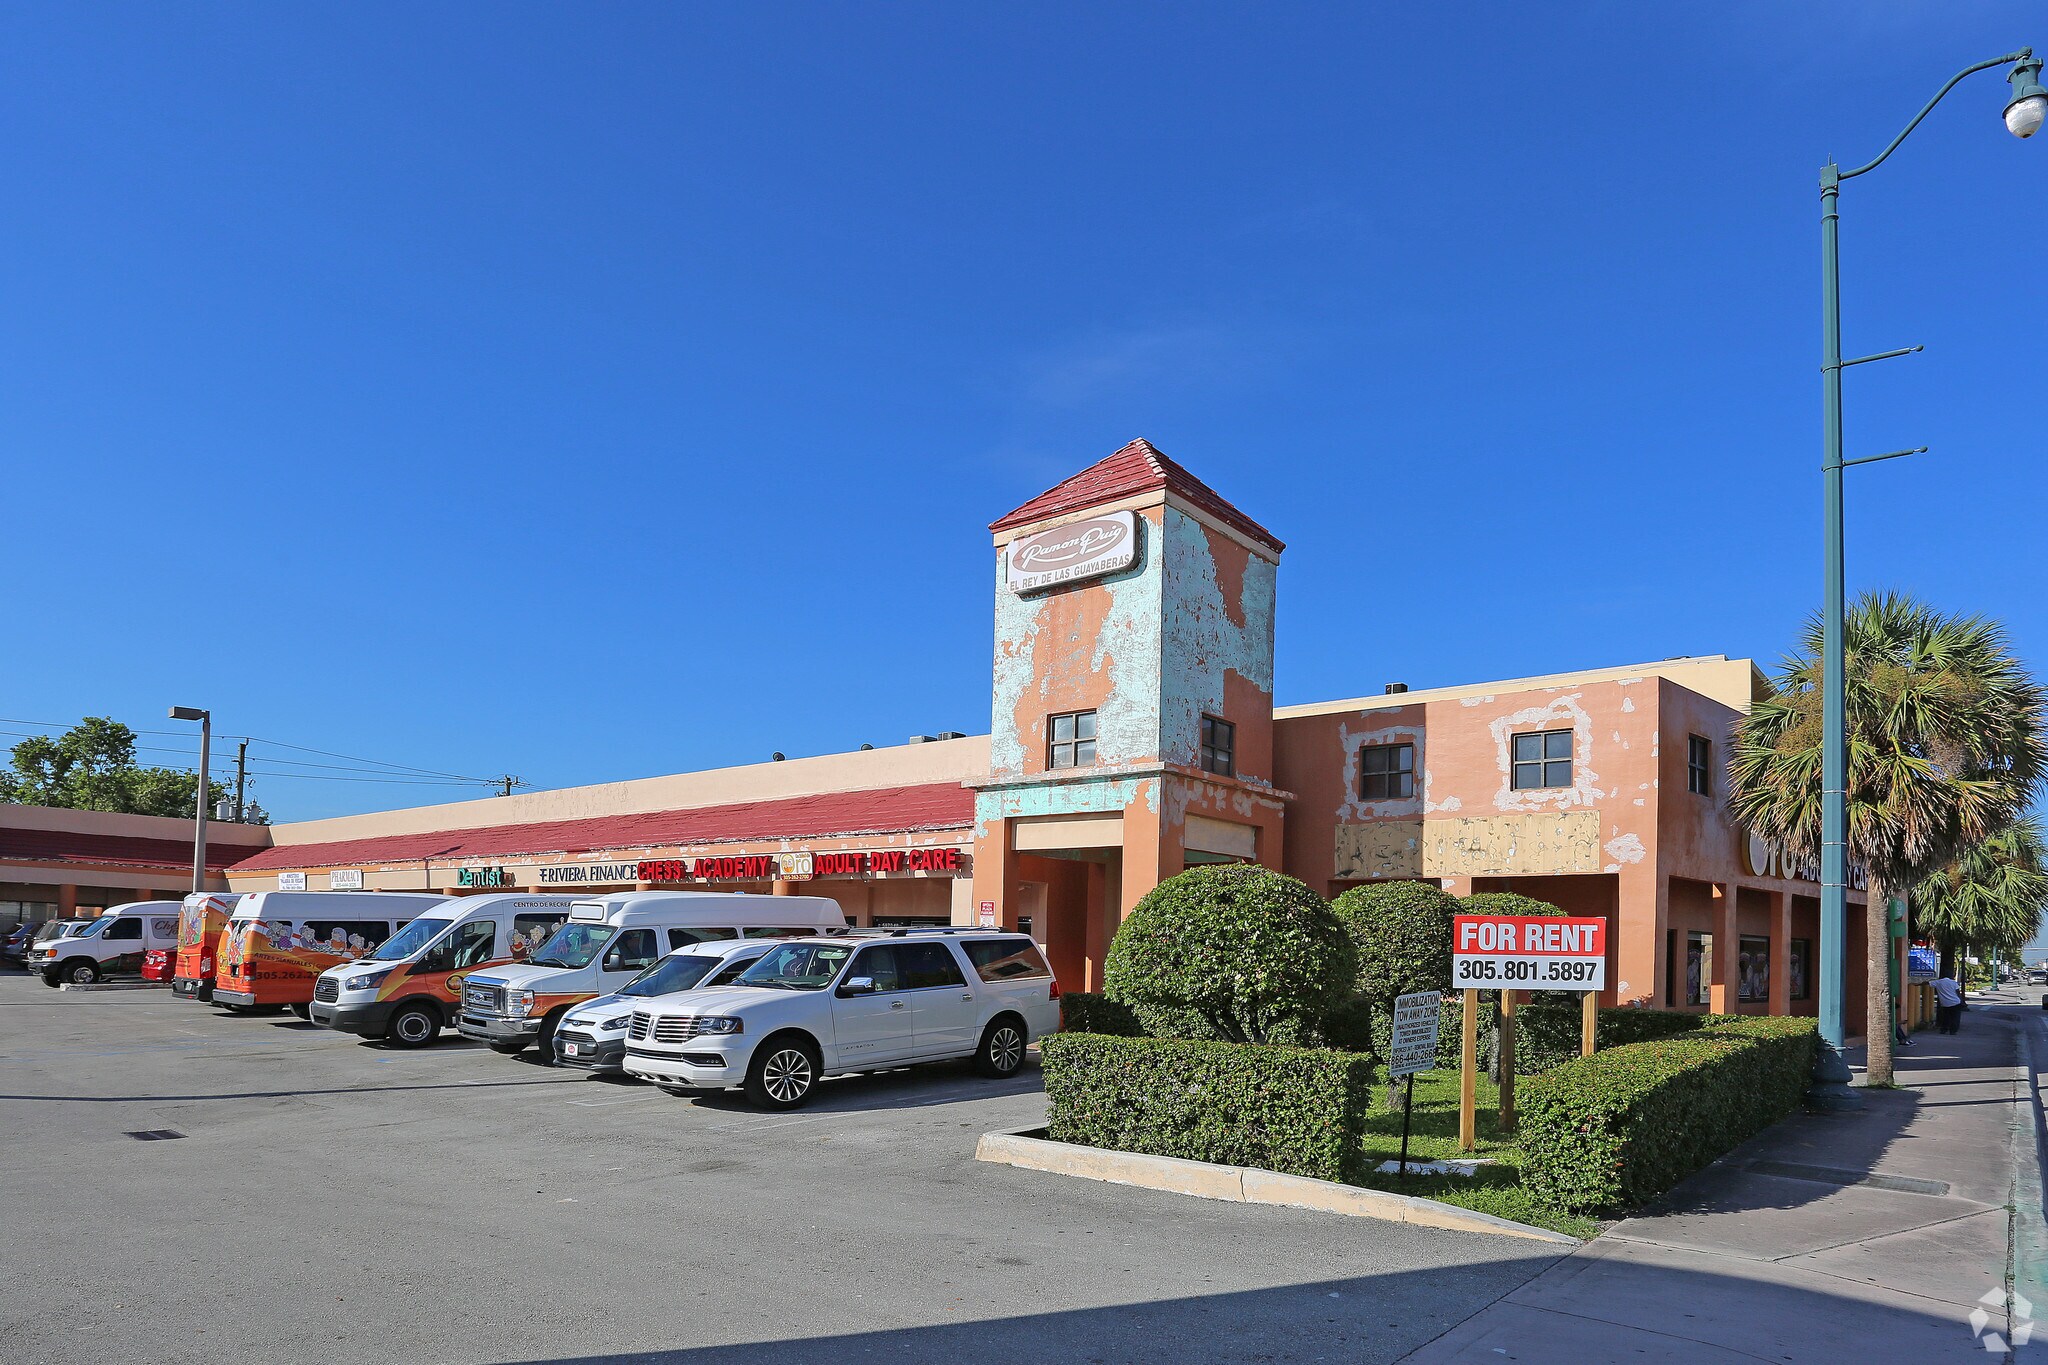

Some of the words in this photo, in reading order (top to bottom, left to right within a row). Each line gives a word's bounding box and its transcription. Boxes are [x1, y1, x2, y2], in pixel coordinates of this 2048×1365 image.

[1080, 525, 1123, 556] Puig
[1010, 580, 1019, 591] EL
[1022, 576, 1038, 588] REY
[1041, 573, 1052, 584] DE
[1055, 568, 1070, 581] LAS
[1074, 553, 1130, 577] GUAYABERAS
[589, 864, 638, 881] FINANCE
[637, 860, 684, 881] CHESS
[693, 855, 770, 879] ACADEMY
[815, 853, 864, 875] ADULT
[870, 850, 903, 872] DAY
[909, 848, 959, 871] CARE
[331, 870, 360, 883] PHARMACY
[458, 867, 501, 886] Dentist
[1460, 922, 1517, 951] FOR
[1524, 922, 1598, 952] RENT
[1459, 959, 1597, 982] 305.801.5897
[1398, 993, 1440, 1009] IMMOBILIZATION
[1397, 1010, 1409, 1022] TOW
[1409, 1008, 1423, 1020] AWAY
[1423, 1005, 1439, 1018] ZONE
